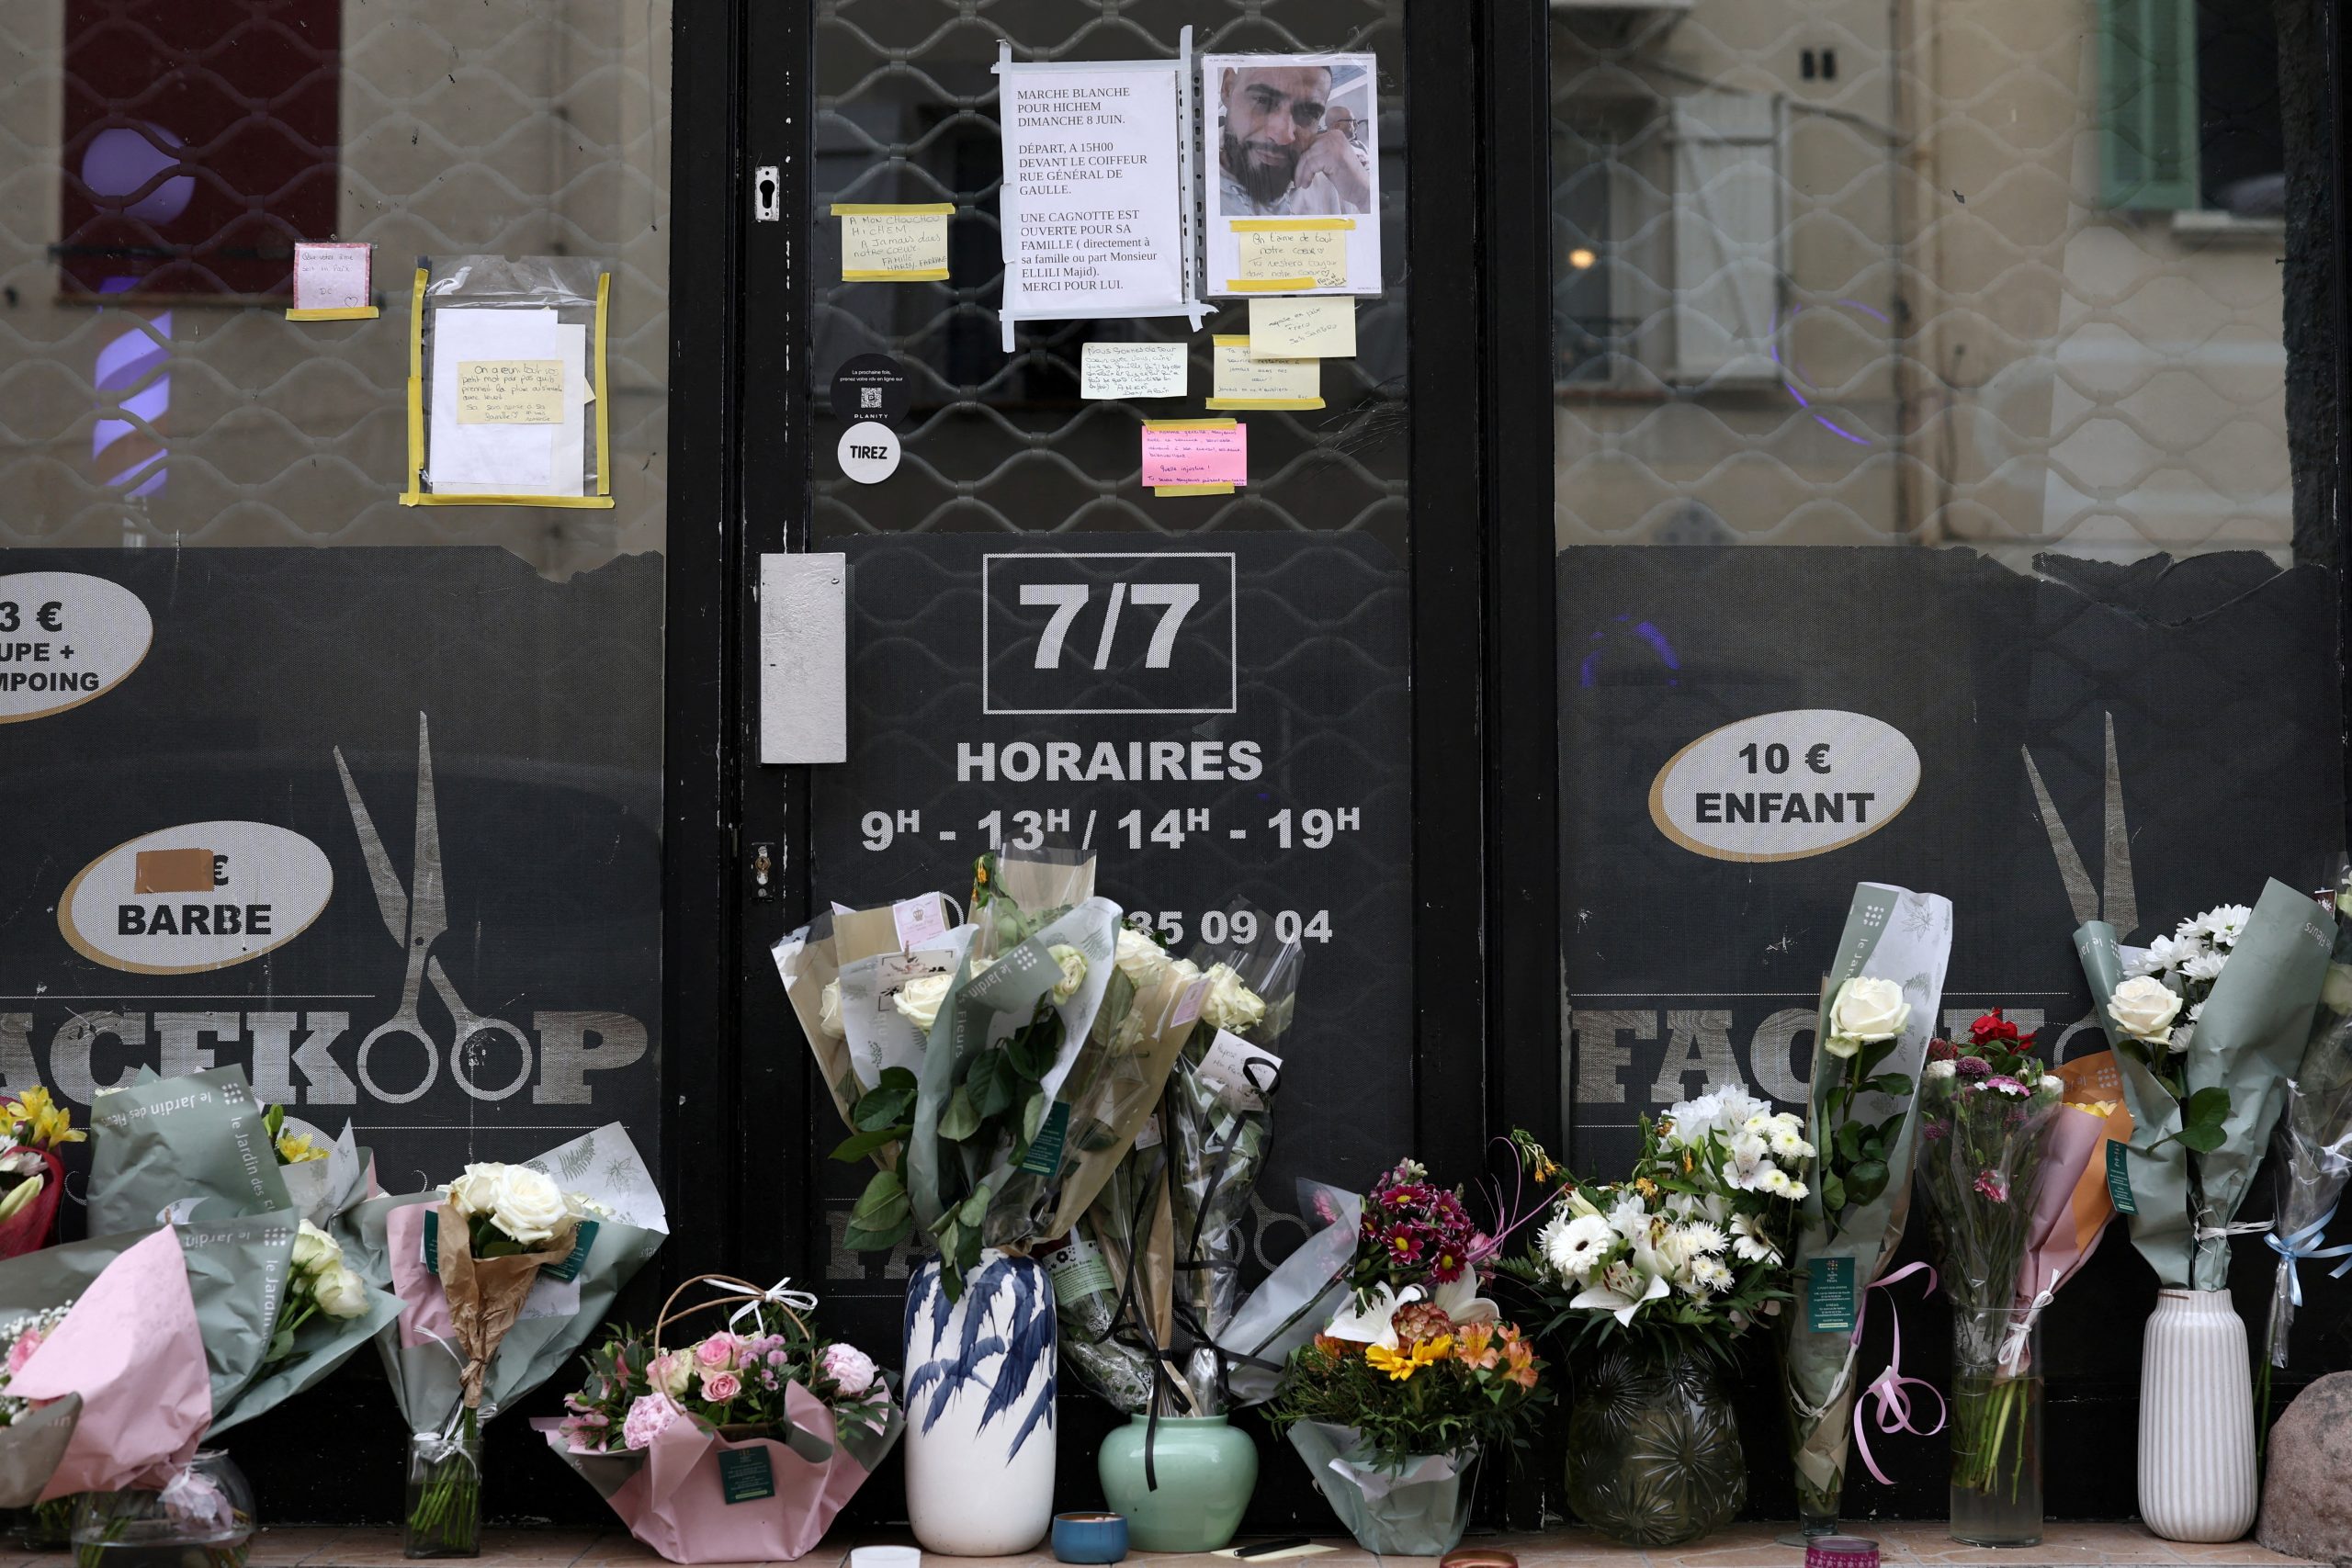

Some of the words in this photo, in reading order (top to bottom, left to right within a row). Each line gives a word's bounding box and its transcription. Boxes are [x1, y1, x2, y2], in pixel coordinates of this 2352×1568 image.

[1017, 89, 1069, 99] MARCHE
[1072, 87, 1130, 98] BLANCHE
[1017, 103, 1050, 114] POUR
[1053, 102, 1102, 113] HICHEM
[1018, 116, 1084, 128] DIMANCHE
[1086, 115, 1093, 125] 8
[1095, 114, 1125, 125] JUIN.
[1019, 142, 1067, 154] DÉPART,
[1069, 143, 1078, 152] A
[1080, 141, 1114, 152] 15H00
[1019, 157, 1068, 168] DEVANT
[1070, 156, 1086, 166] LE
[1088, 154, 1148, 166] COIFFEUR
[1020, 172, 1044, 182] RUE
[1046, 168, 1104, 181] GÉNÉRAL
[1106, 169, 1123, 179] DE
[1019, 184, 1072, 196] GAULLE.
[1021, 212, 1046, 223] UNE
[1048, 210, 1115, 222] CAGNOTTE
[1117, 209, 1140, 220] EST
[1021, 225, 1078, 237] OUVERTE
[1080, 224, 1114, 235] POUR
[1115, 223, 1133, 234] SA
[1021, 239, 1074, 251] FAMILLE
[1083, 238, 1142, 249] directement
[1144, 236, 1150, 247] à
[1035, 254, 1070, 265] famille
[1087, 253, 1108, 265] part
[1110, 251, 1158, 262] Monsieur
[1022, 267, 1060, 278] ELLILI
[1063, 265, 1100, 279] Majid).
[1022, 281, 1061, 292] MERCI
[1064, 280, 1097, 291] POUR
[1100, 279, 1124, 290] LUI.
[850, 445, 888, 460] TIREZ
[1019, 582, 1200, 671] 7/7
[956, 740, 1263, 783] HORAIRES
[1738, 742, 1790, 774] 10
[1804, 742, 1832, 774] €
[1695, 792, 1875, 824] ENFANT
[118, 904, 272, 936] BARBE
[1200, 909, 1258, 944] 09
[1274, 909, 1333, 944] 04
[151, 1095, 197, 1117] Jardin
[235, 1133, 259, 1176] Jardin
